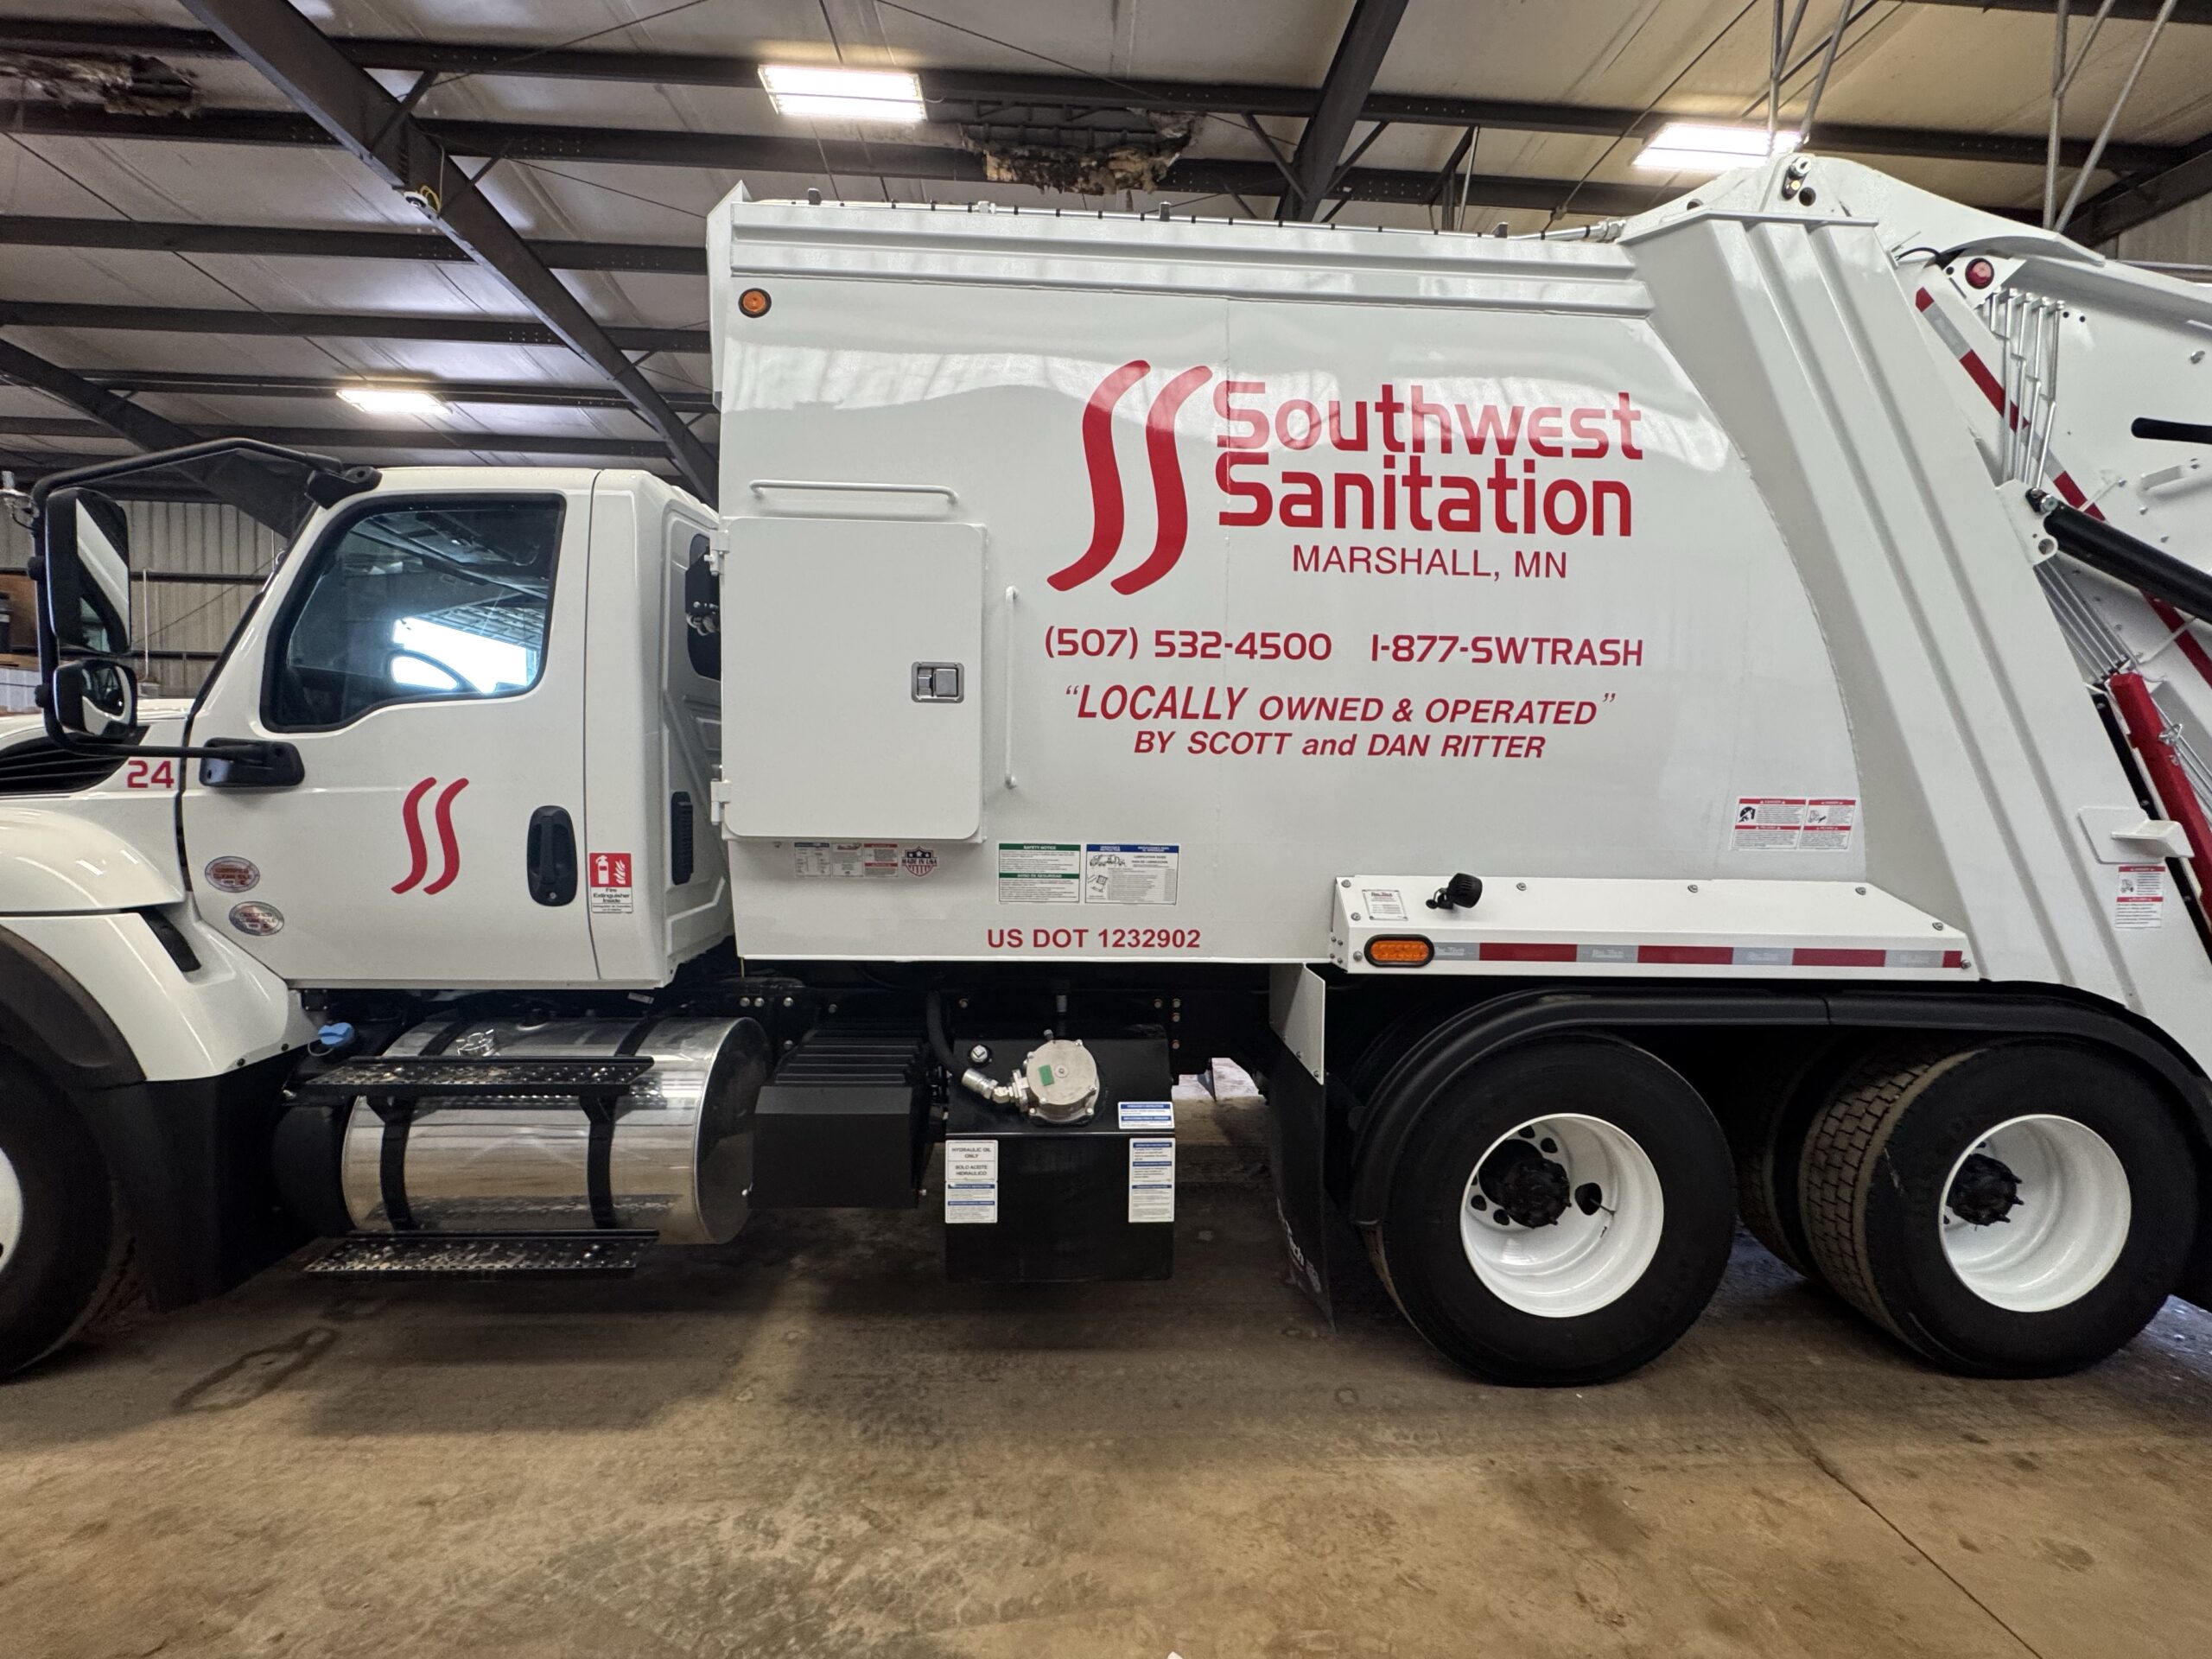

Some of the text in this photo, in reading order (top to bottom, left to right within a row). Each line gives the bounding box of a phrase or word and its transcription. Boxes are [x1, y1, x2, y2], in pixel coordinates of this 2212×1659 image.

[1213, 380, 1643, 461] Southwest
[1215, 452, 1633, 537] Sanitation
[1293, 544, 1567, 582] MARSHALL, MN
[1045, 626, 1139, 659] (507)
[1154, 629, 1332, 661] 532-4500
[1259, 696, 1384, 722] OWNED
[1392, 697, 1413, 722] &
[1134, 730, 1547, 759] BY SCOTT and DAN RITTER
[126, 760, 175, 789] 24
[987, 928, 1201, 949] US DOT 1232902
